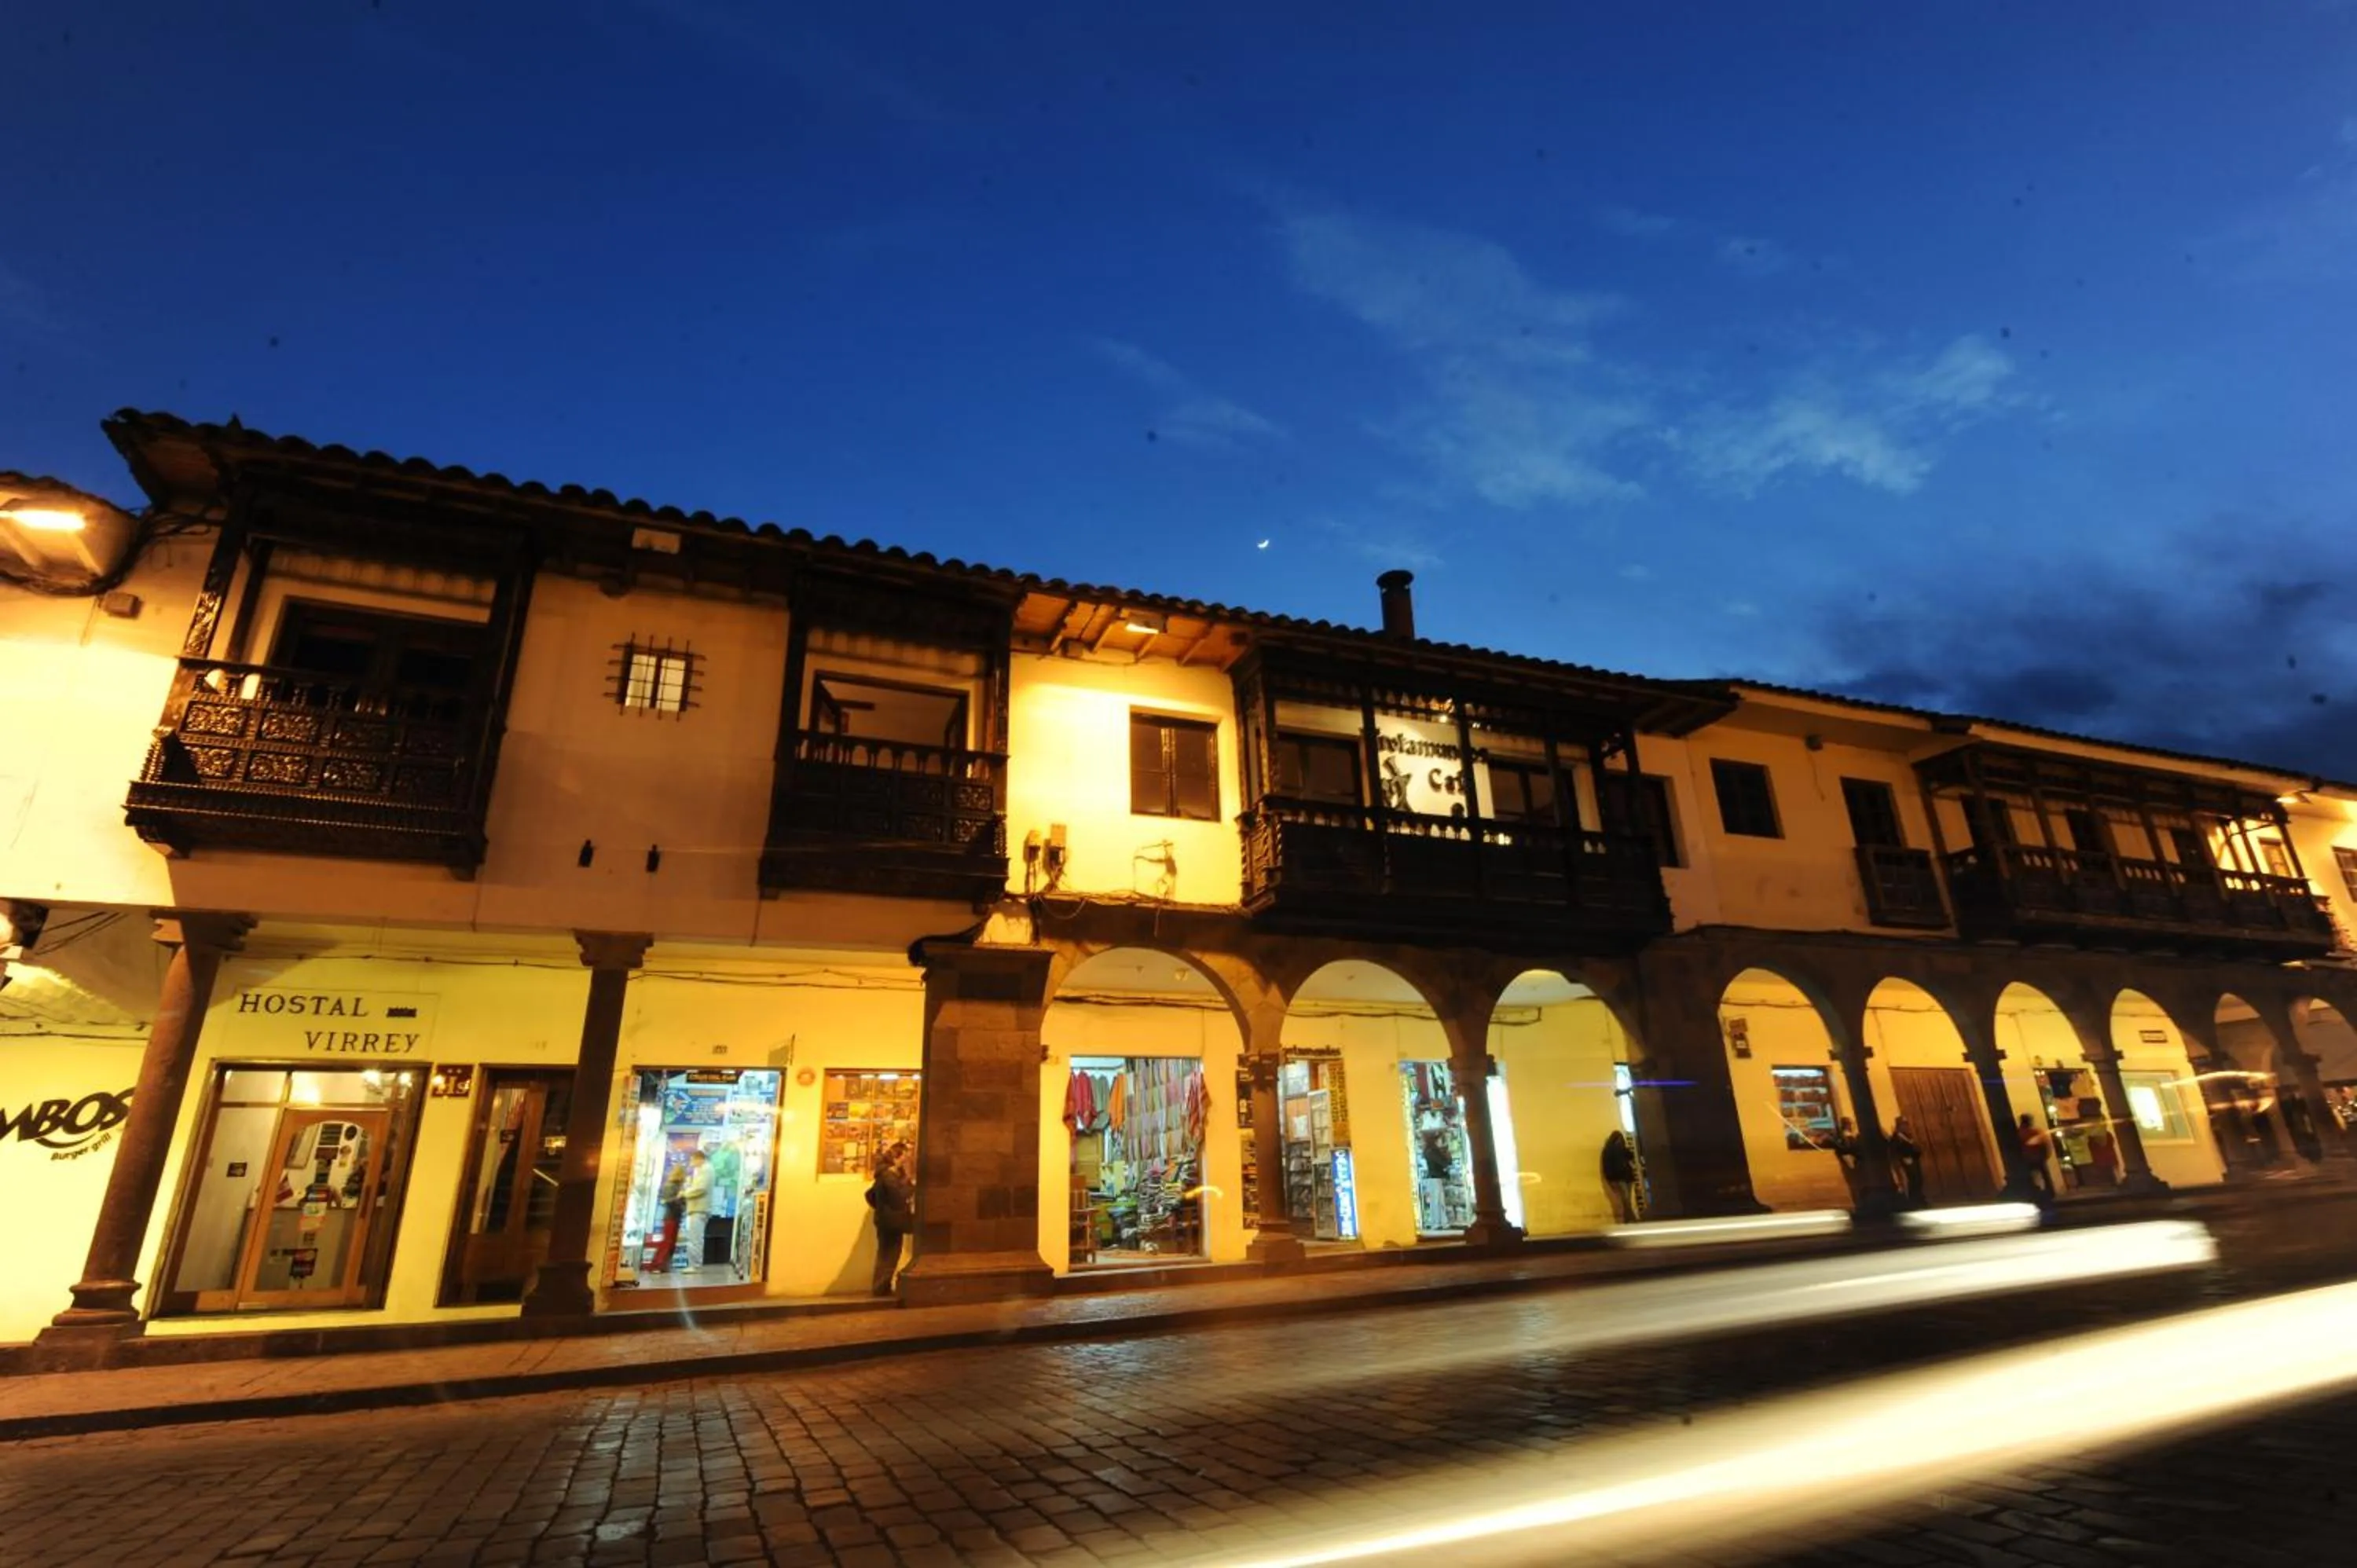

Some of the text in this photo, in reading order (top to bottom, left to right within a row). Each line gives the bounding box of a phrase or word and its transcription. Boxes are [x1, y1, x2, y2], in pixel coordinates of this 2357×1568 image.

[1428, 768, 1468, 795] Caf
[238, 993, 369, 1017] HOSTAL
[304, 1031, 420, 1053] VIRREY
